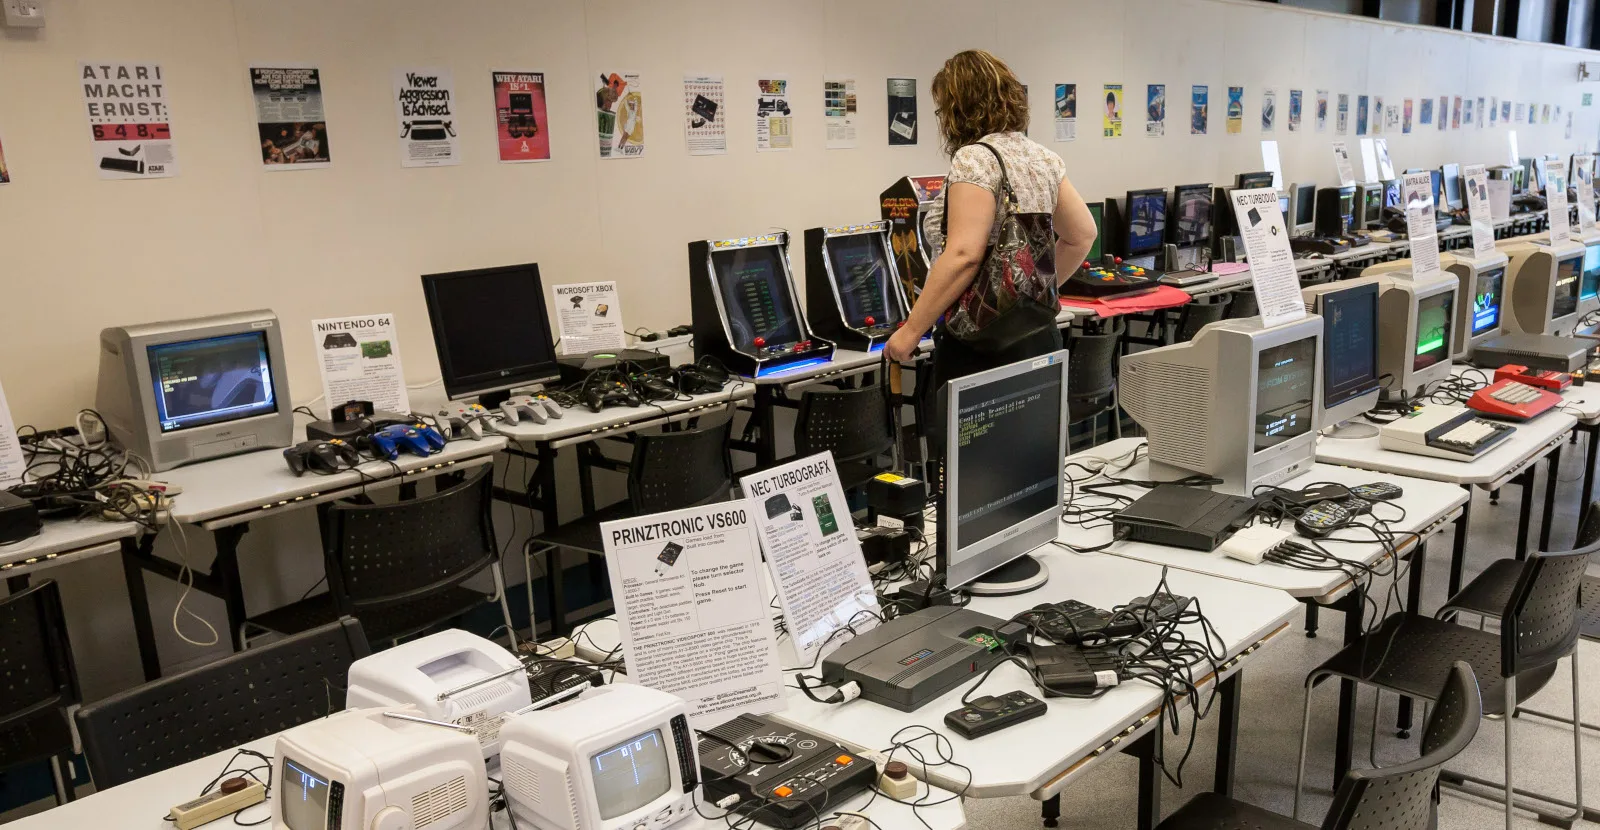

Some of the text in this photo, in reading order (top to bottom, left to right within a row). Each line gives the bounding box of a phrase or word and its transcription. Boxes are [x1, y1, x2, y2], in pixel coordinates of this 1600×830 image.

[83, 65, 161, 80] ATARI
[494, 73, 542, 83] WHY ATARI
[406, 73, 438, 88] Viewer
[510, 82, 519, 90] IS
[84, 84, 162, 98] MACHT
[398, 88, 450, 104] Aggression
[88, 102, 167, 116] ERNST:
[403, 102, 450, 116] Is Advised.
[882, 197, 918, 209] GOLDEN
[1236, 192, 1277, 205] NEC TURBODUO
[890, 206, 910, 217] AXE
[557, 286, 594, 295] MICROSOFT
[318, 318, 390, 332] NINTENDO 64
[958, 393, 1040, 424] English Translation 2012
[750, 460, 832, 498] NEC TURBOGRAFX
[958, 482, 1038, 522] English Translation 2012
[611, 509, 747, 546] PRINZTRONIC VS600
[698, 565, 718, 574] change
[728, 560, 743, 568] game
[692, 573, 710, 582] please
[722, 567, 744, 576] selector
[695, 589, 710, 597] Press
[711, 586, 727, 594] Reset
[734, 582, 746, 590] start
